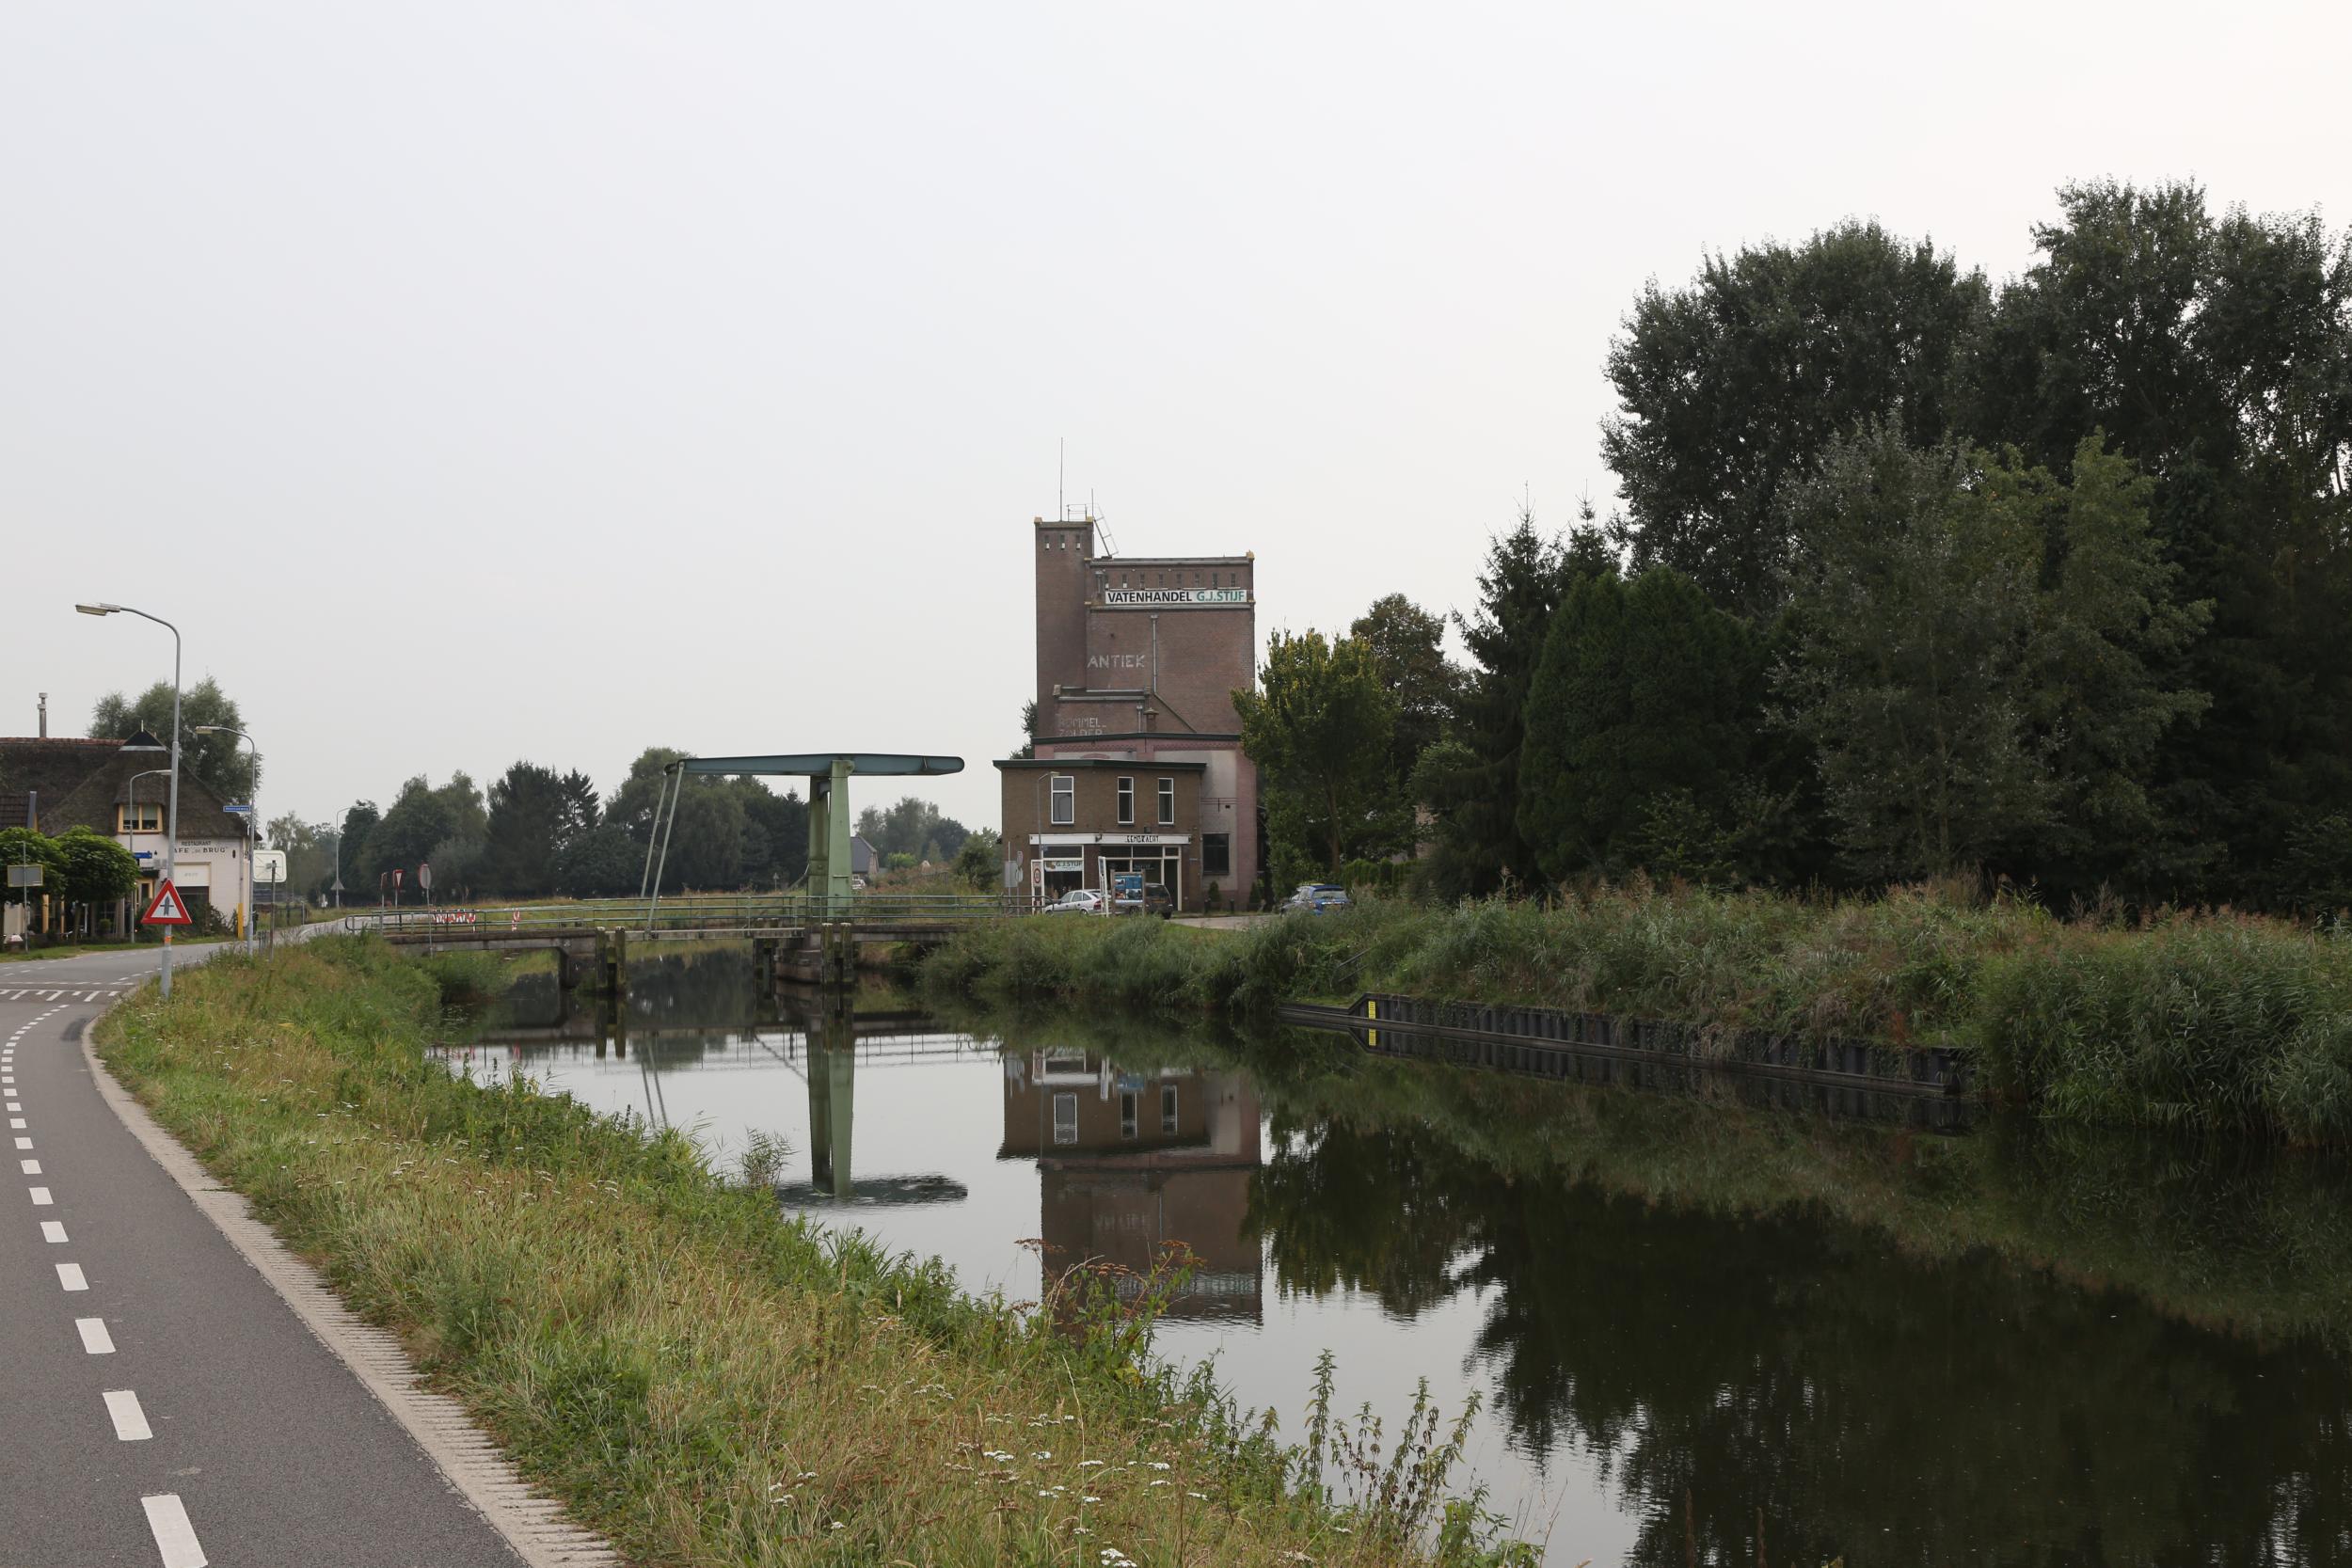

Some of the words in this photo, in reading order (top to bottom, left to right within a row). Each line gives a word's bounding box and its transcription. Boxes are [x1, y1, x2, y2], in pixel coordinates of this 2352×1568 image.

[1107, 591, 1192, 603] VATENHANDEL
[1196, 590, 1246, 602] G.J.STIJF
[1087, 655, 1145, 668] ANTIEK
